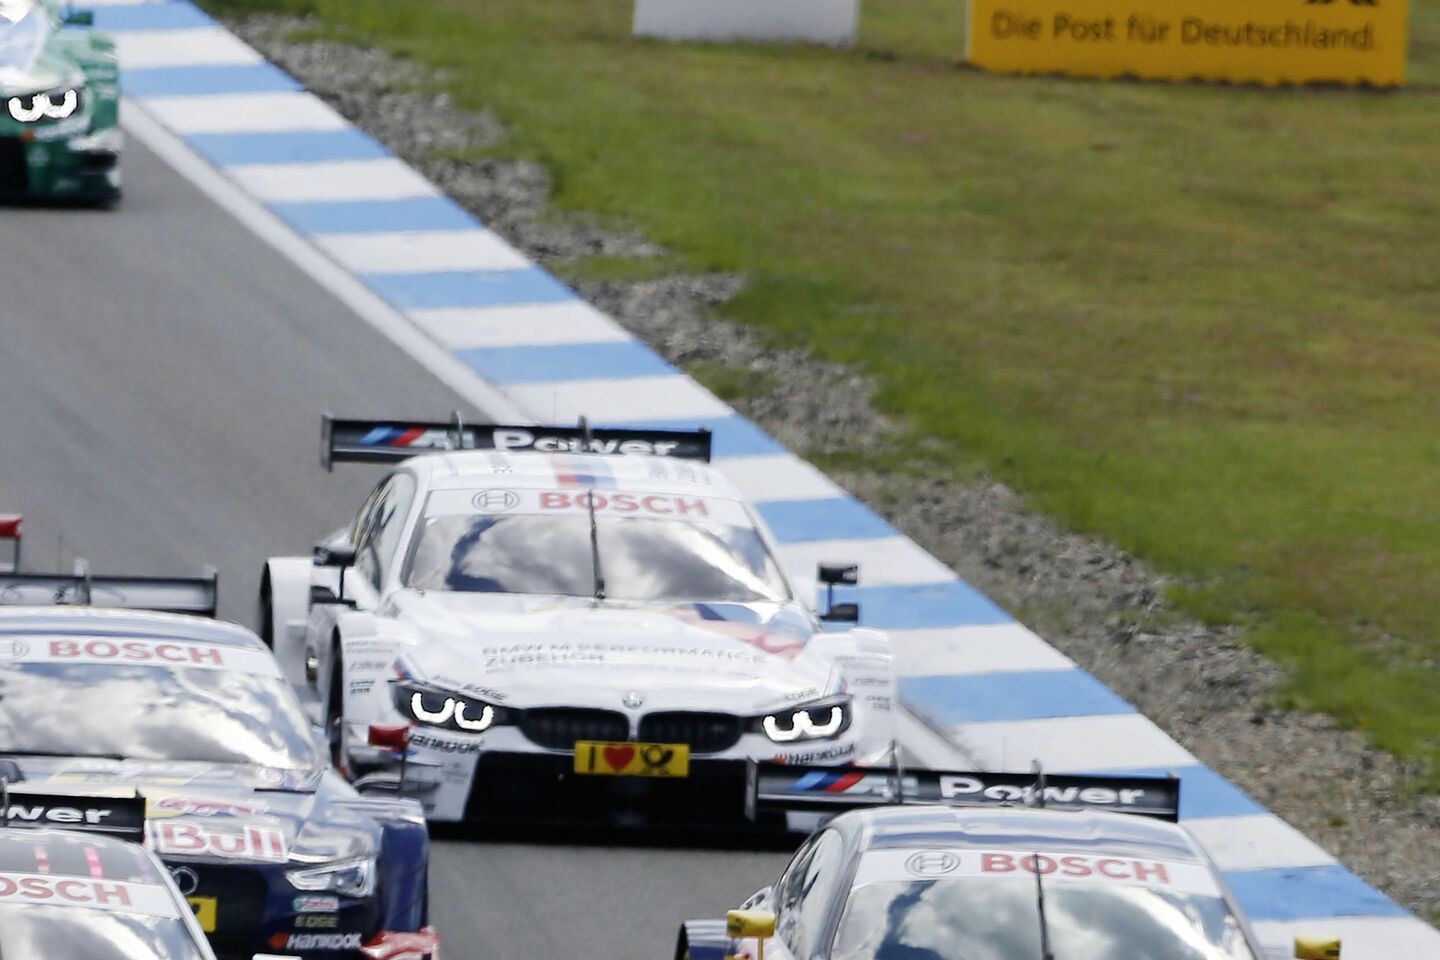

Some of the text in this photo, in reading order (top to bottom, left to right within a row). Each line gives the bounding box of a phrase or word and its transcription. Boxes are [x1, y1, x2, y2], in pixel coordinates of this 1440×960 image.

[991, 11, 1043, 41] Die
[1053, 13, 1116, 43] Post
[1127, 13, 1170, 44] für
[492, 426, 680, 456] Power
[539, 491, 710, 518] BOSCH
[49, 639, 225, 665] BOSCH
[588, 746, 596, 771] I
[938, 774, 1146, 805] Power
[159, 822, 286, 862] Bull
[980, 853, 1171, 884] BOSCH
